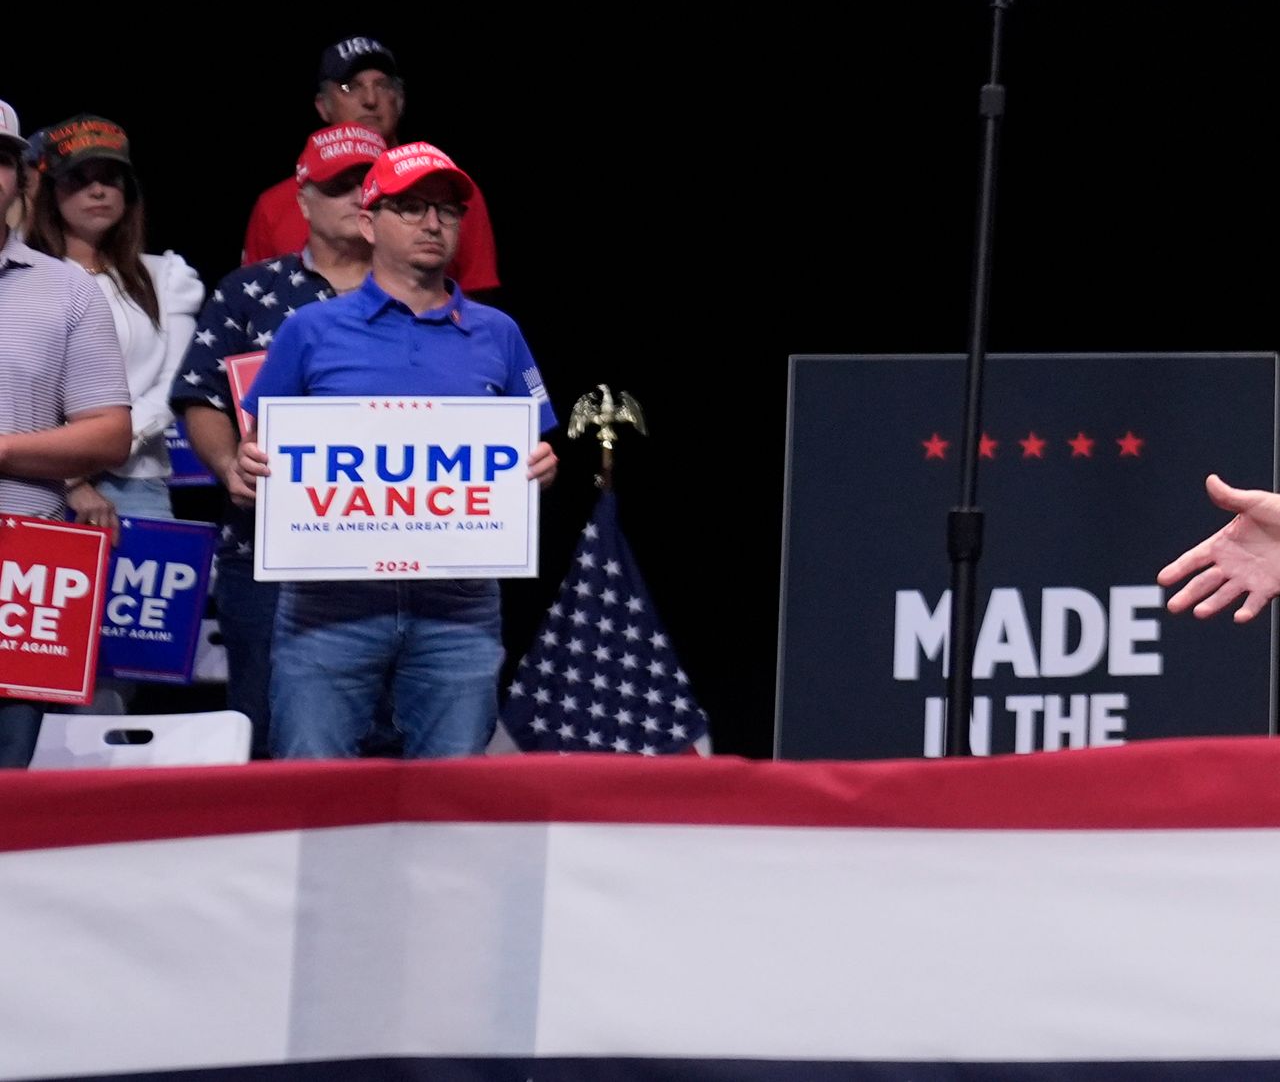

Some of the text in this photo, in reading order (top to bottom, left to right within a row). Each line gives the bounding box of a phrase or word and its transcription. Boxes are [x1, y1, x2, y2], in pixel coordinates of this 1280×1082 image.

[312, 126, 342, 149] MAKE
[320, 140, 354, 161] GREAT
[386, 144, 419, 164] MAKE
[394, 155, 431, 177] GREAT
[277, 444, 519, 483] TRUMP
[304, 485, 491, 517] VANCE
[290, 521, 504, 532] MAKE AMERICA GREAT AGAIN!
[111, 557, 198, 599] MP
[374, 561, 421, 573] 2024
[106, 594, 168, 629] CE
[128, 629, 174, 643] AGAIN!
[893, 585, 1164, 681] MADE
[20, 641, 69, 656] AGAIN!
[1004, 692, 1129, 756] THE
